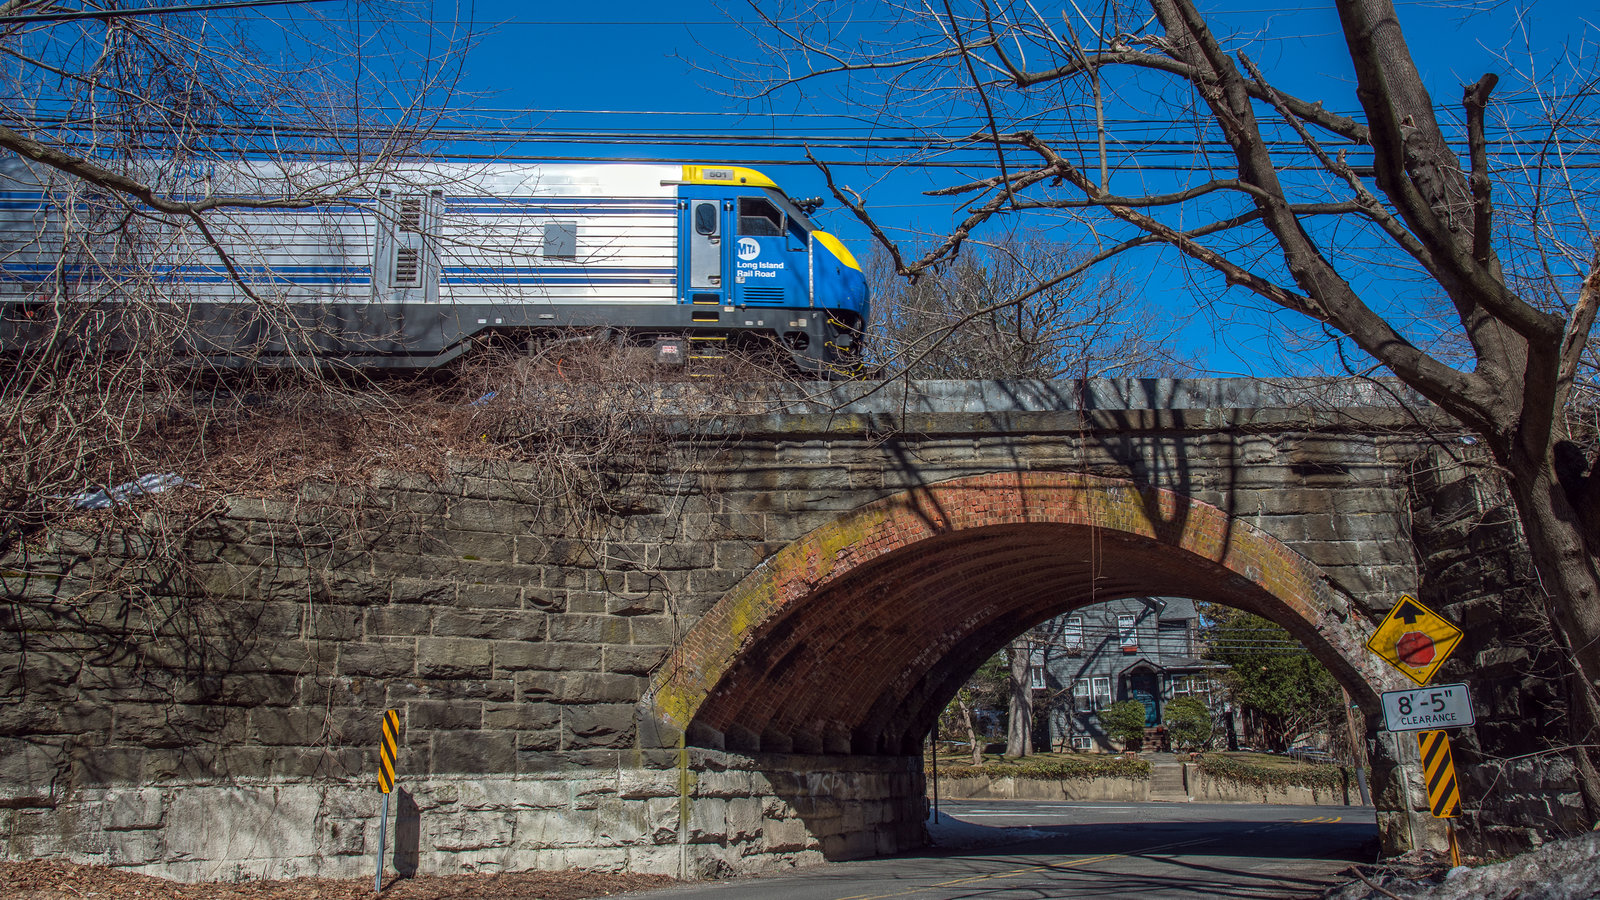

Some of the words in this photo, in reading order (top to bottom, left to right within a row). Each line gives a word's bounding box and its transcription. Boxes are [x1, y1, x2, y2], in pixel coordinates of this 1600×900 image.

[737, 241, 757, 256] MTA
[736, 261, 758, 270] Long
[759, 261, 785, 269] Island
[754, 270, 776, 278] Road
[1401, 712, 1457, 725] CLEARANCE
